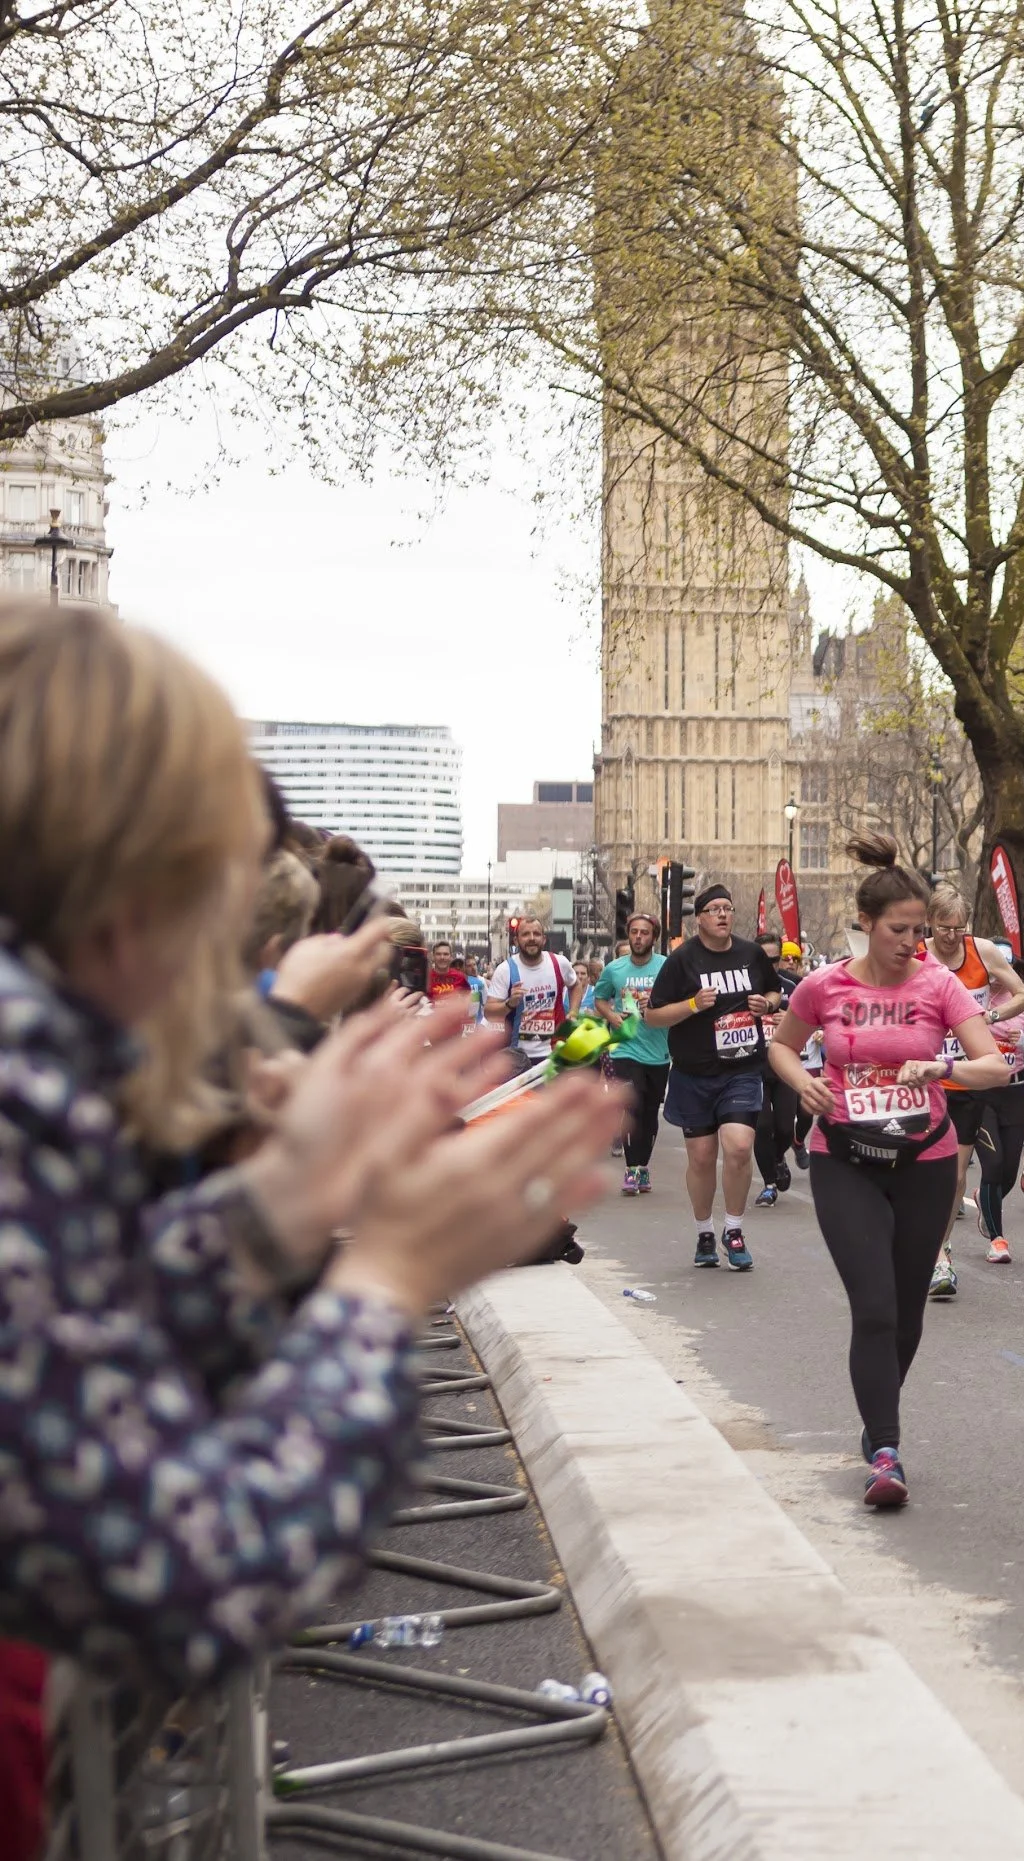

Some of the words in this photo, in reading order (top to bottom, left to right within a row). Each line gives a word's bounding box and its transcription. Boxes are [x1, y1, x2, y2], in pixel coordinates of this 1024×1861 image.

[530, 985, 552, 994] ADAM
[625, 976, 654, 988] JAMES
[700, 968, 753, 995] IAIN
[841, 1001, 917, 1026] SOPHIE
[722, 1027, 754, 1045] 2004
[850, 1087, 926, 1115] 51780
